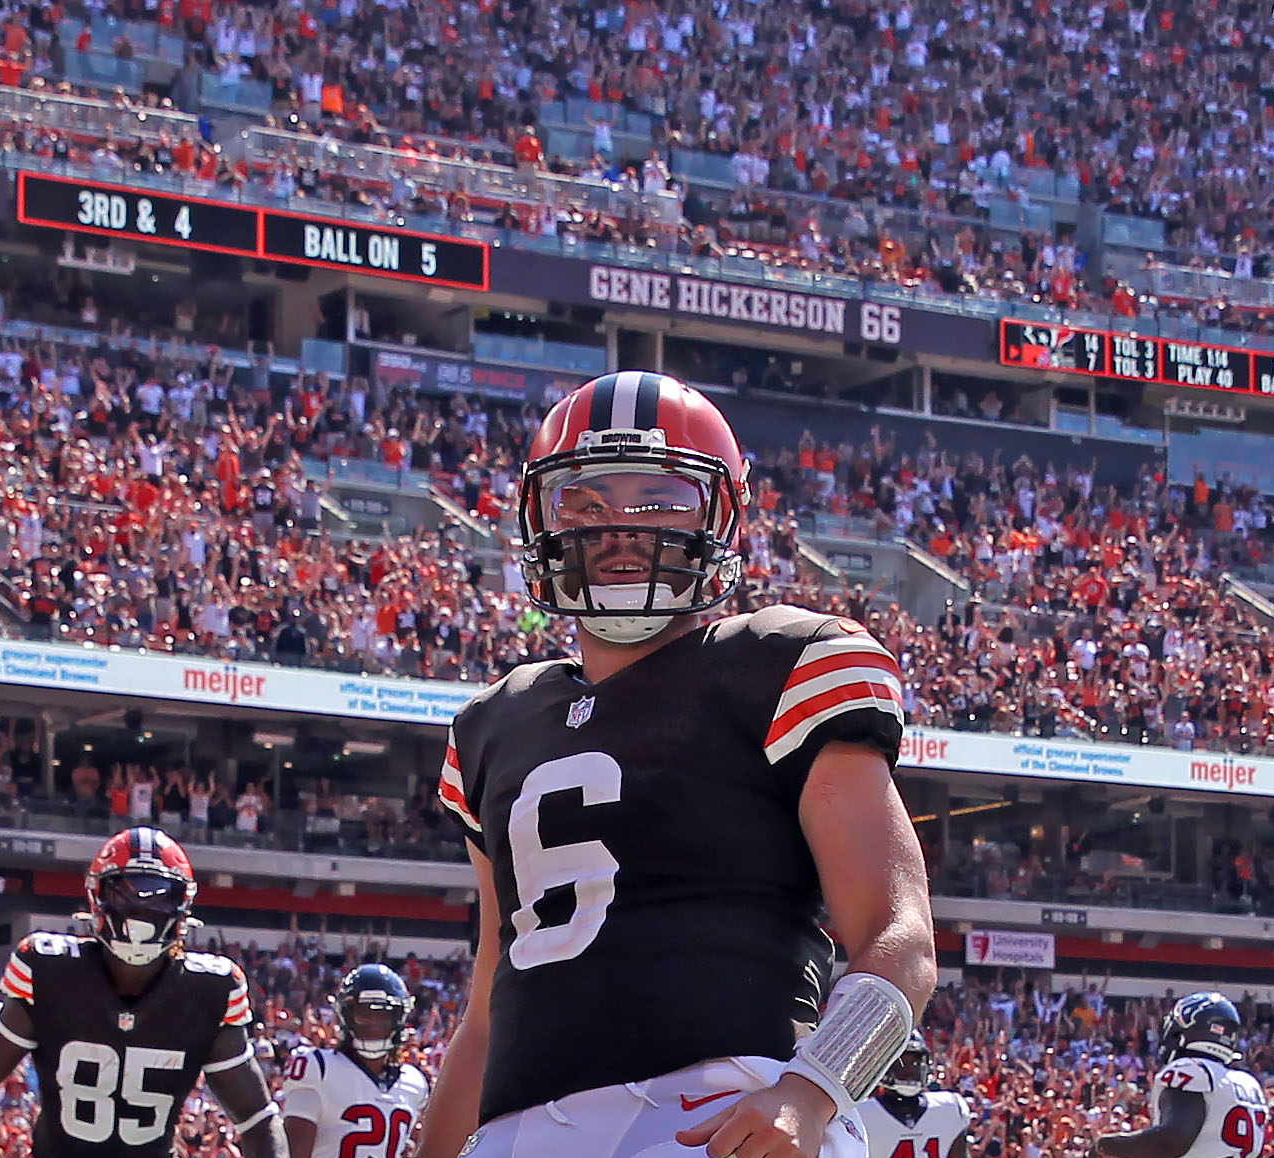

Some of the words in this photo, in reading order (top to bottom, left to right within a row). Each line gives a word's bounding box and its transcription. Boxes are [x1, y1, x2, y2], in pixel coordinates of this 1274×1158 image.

[77, 190, 125, 230] 3RD
[136, 198, 156, 233] &
[174, 206, 191, 239] 4
[304, 224, 362, 267] BALL
[368, 234, 399, 271] ON
[420, 242, 436, 276] 5
[590, 265, 670, 309] GENE
[676, 277, 846, 334] HICKERSON
[860, 302, 901, 344] 66
[1114, 336, 1140, 358] TOL
[1144, 340, 1154, 359] 3
[1168, 343, 1203, 365] TIME
[1113, 356, 1140, 377] TOL
[1144, 360, 1155, 379] 3
[1178, 364, 1212, 385] PLAY
[1216, 369, 1233, 388] 40
[184, 667, 265, 702] meijer
[900, 731, 948, 763] eijer
[1190, 755, 1256, 790] meijer
[509, 751, 622, 970] 6
[992, 935, 1050, 951] University
[992, 951, 1045, 965] Hospitals
[56, 1041, 186, 1145] 85
